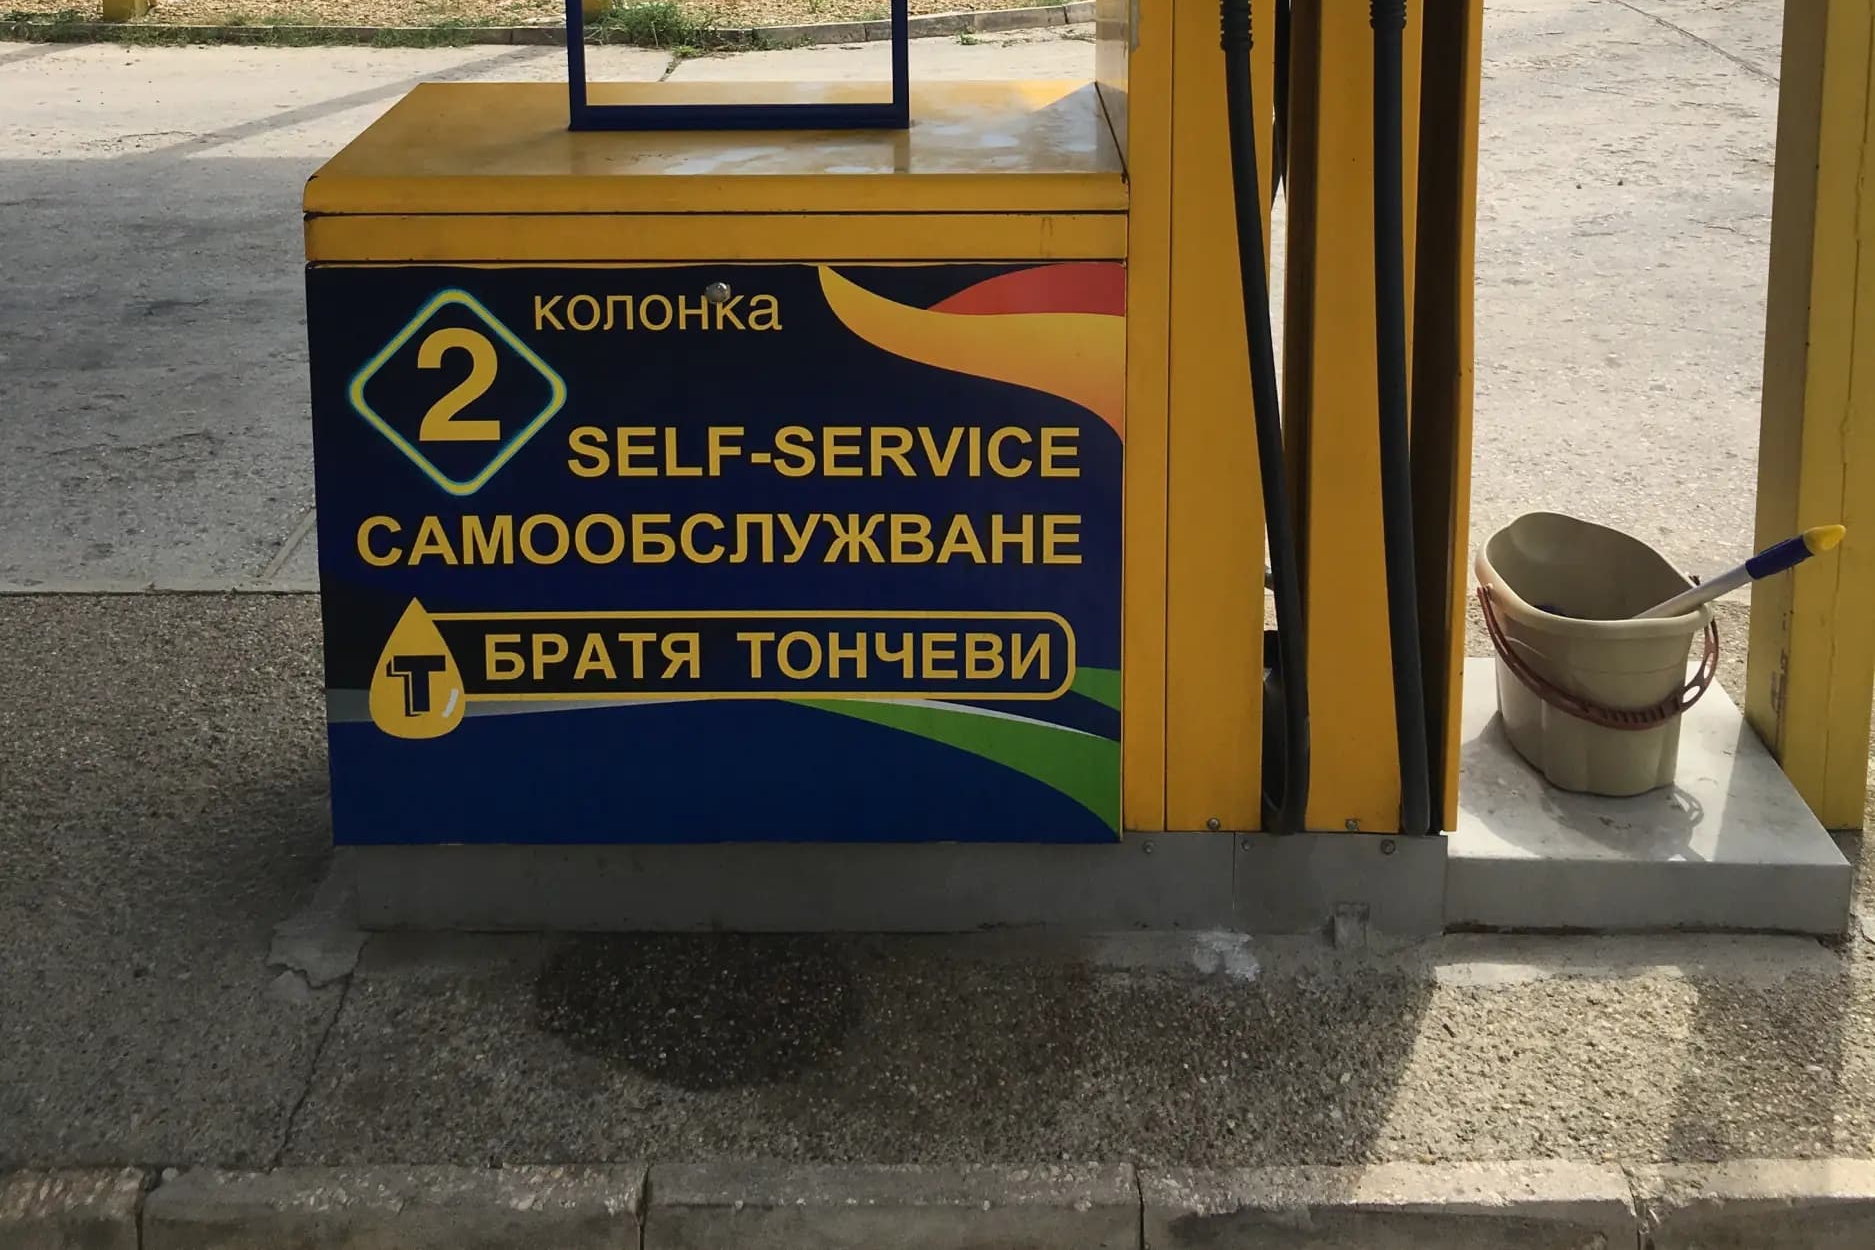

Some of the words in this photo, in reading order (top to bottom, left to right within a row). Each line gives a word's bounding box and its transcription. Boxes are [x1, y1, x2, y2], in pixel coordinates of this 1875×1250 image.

[534, 291, 782, 332] колонка
[417, 328, 501, 442] 2
[568, 426, 1081, 479] SELF-SERVICE
[357, 513, 1082, 567] САМООБСЛУЖВАНЕ
[485, 632, 701, 682] БРАТЯ
[737, 631, 1051, 681] ТОНЧЕВИ
